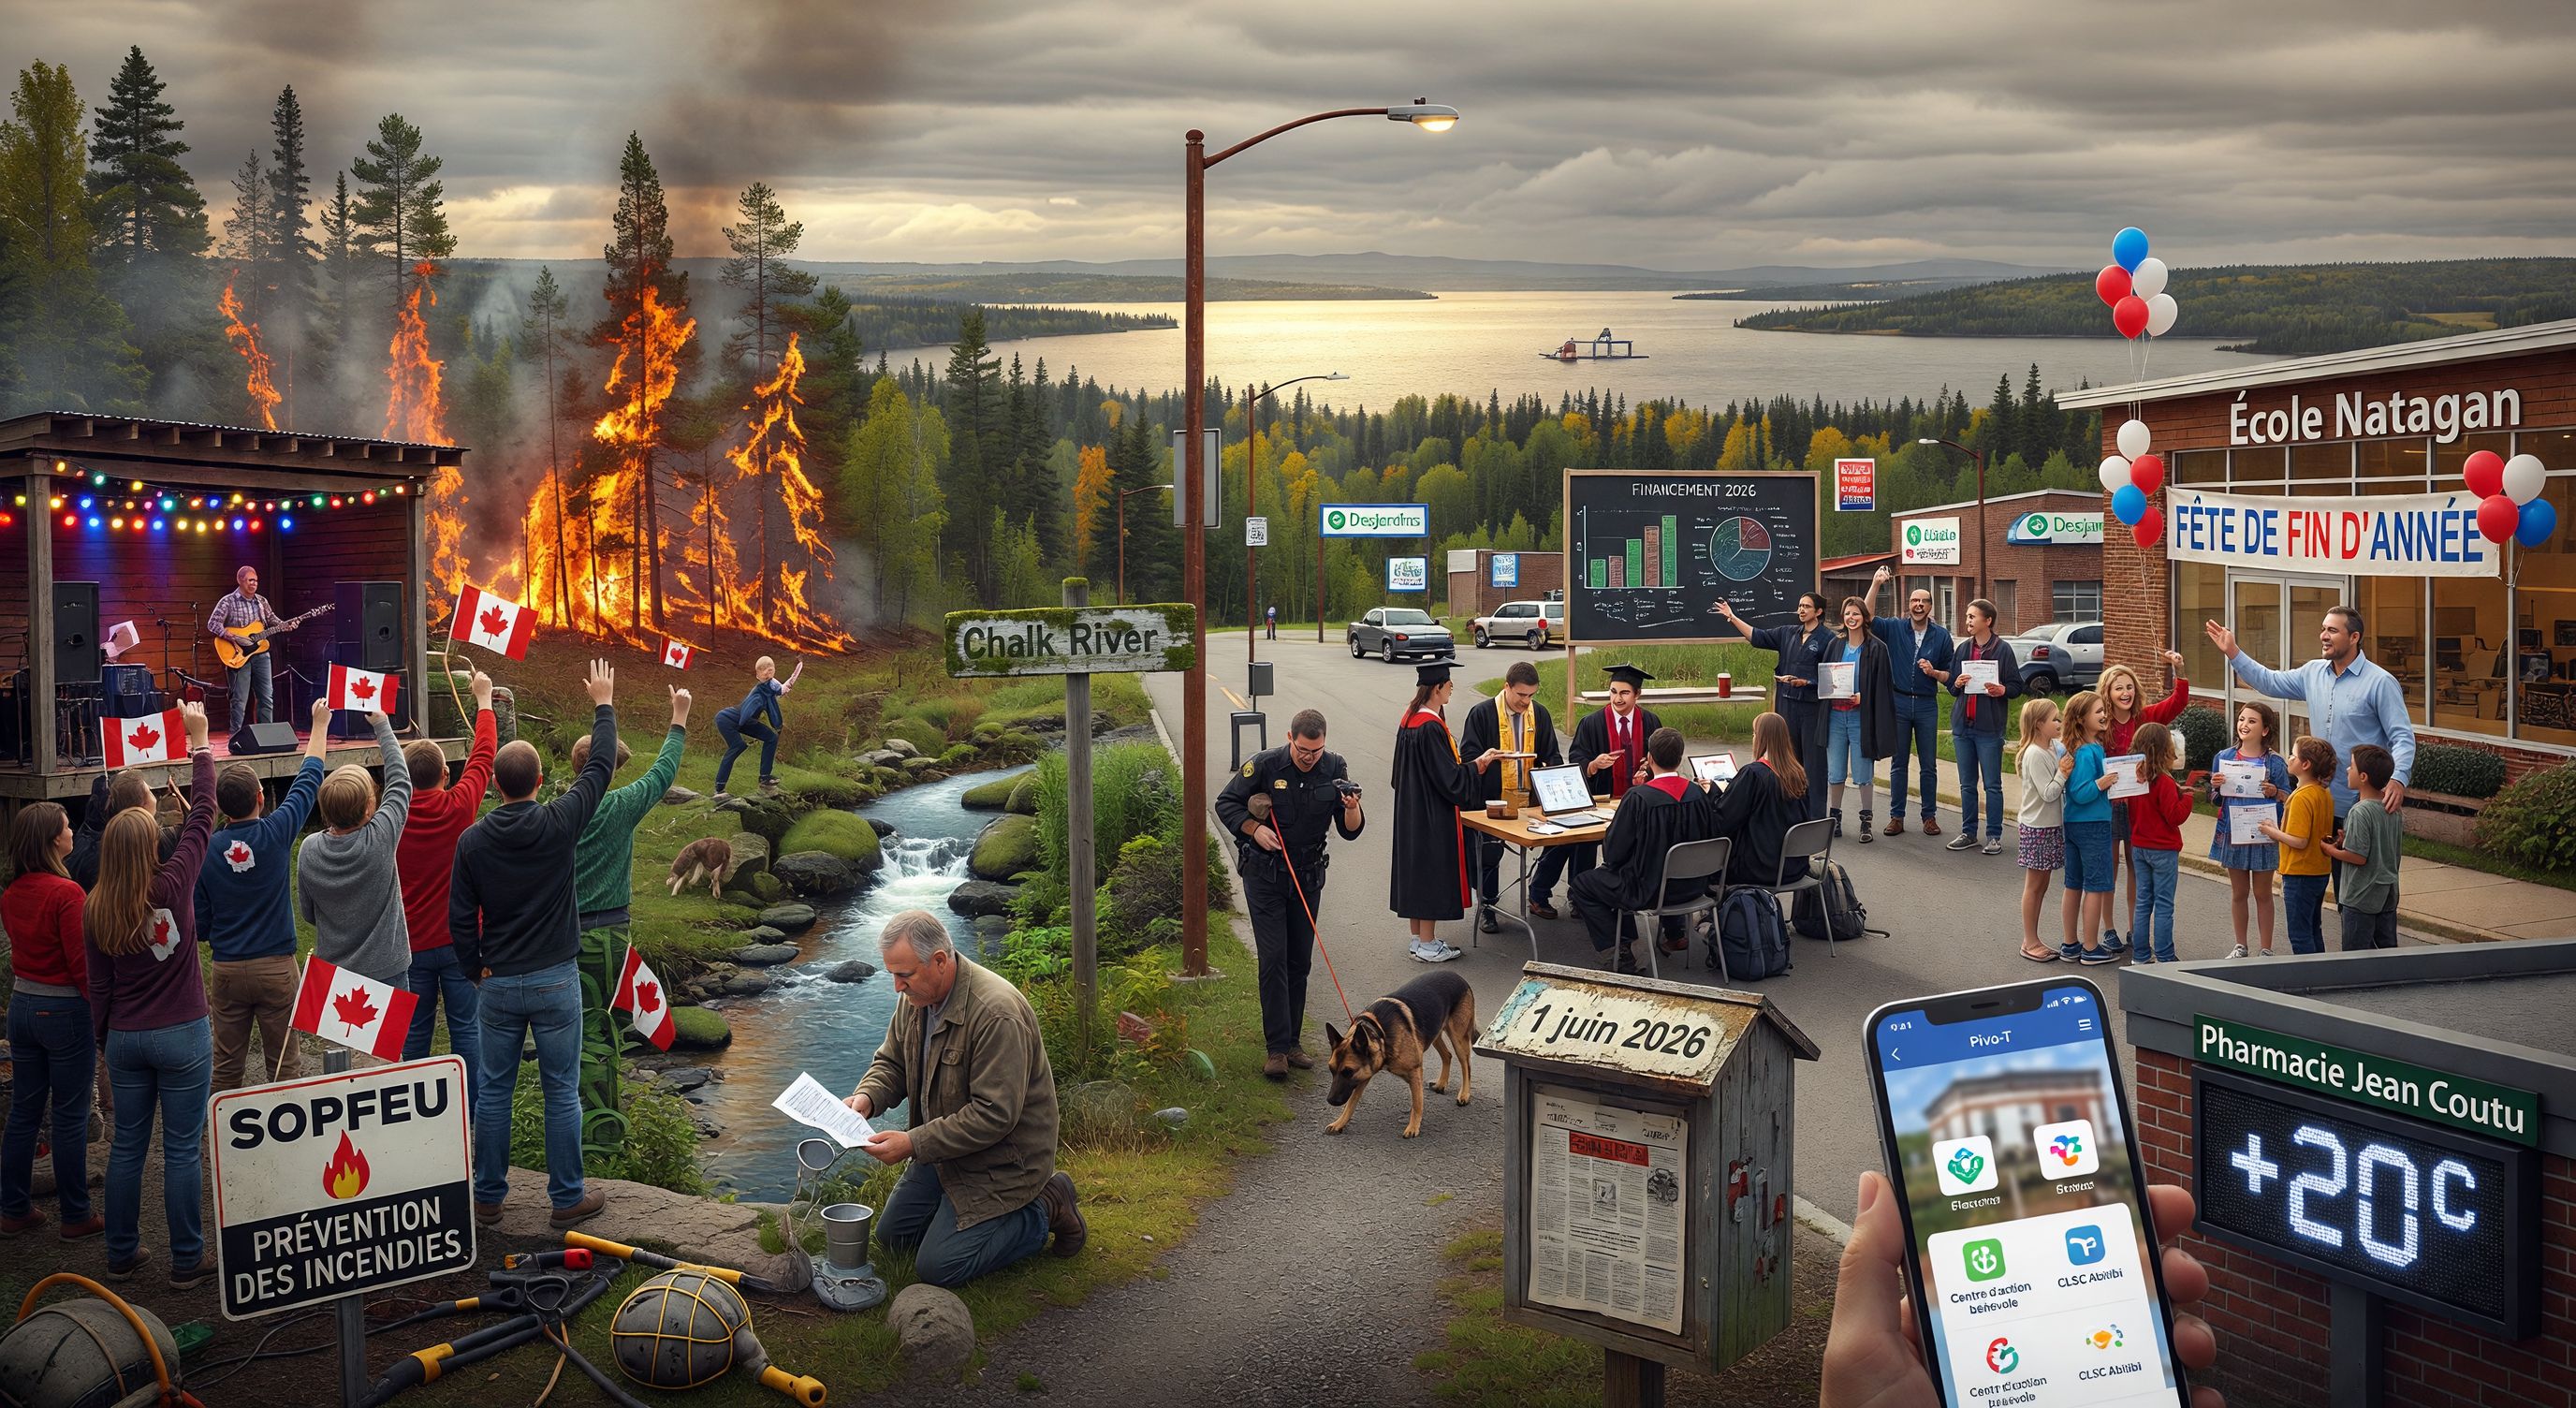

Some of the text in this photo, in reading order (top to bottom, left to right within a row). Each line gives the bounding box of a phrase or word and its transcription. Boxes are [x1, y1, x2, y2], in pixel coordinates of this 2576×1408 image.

[2229, 388, 2521, 446] École Natagan
[1725, 484, 1757, 497] 2026
[2174, 495, 2483, 562] FÊTE DE FIN D'ANNÉE
[963, 623, 1159, 659] Chalk River
[1531, 1004, 1711, 1059] 1 juin 2026
[1969, 1030, 2012, 1048] Pivo-T
[2201, 1024, 2525, 1135] Pharmacie Jean Coutu
[228, 1078, 448, 1150] SOPFEU
[253, 1195, 442, 1262] PRÉVENTION
[235, 1228, 462, 1305] DES INCENDIES
[2057, 1274, 2087, 1288] CLSC
[1950, 1290, 1987, 1303] Centre
[2078, 1367, 2107, 1381] CLSC
